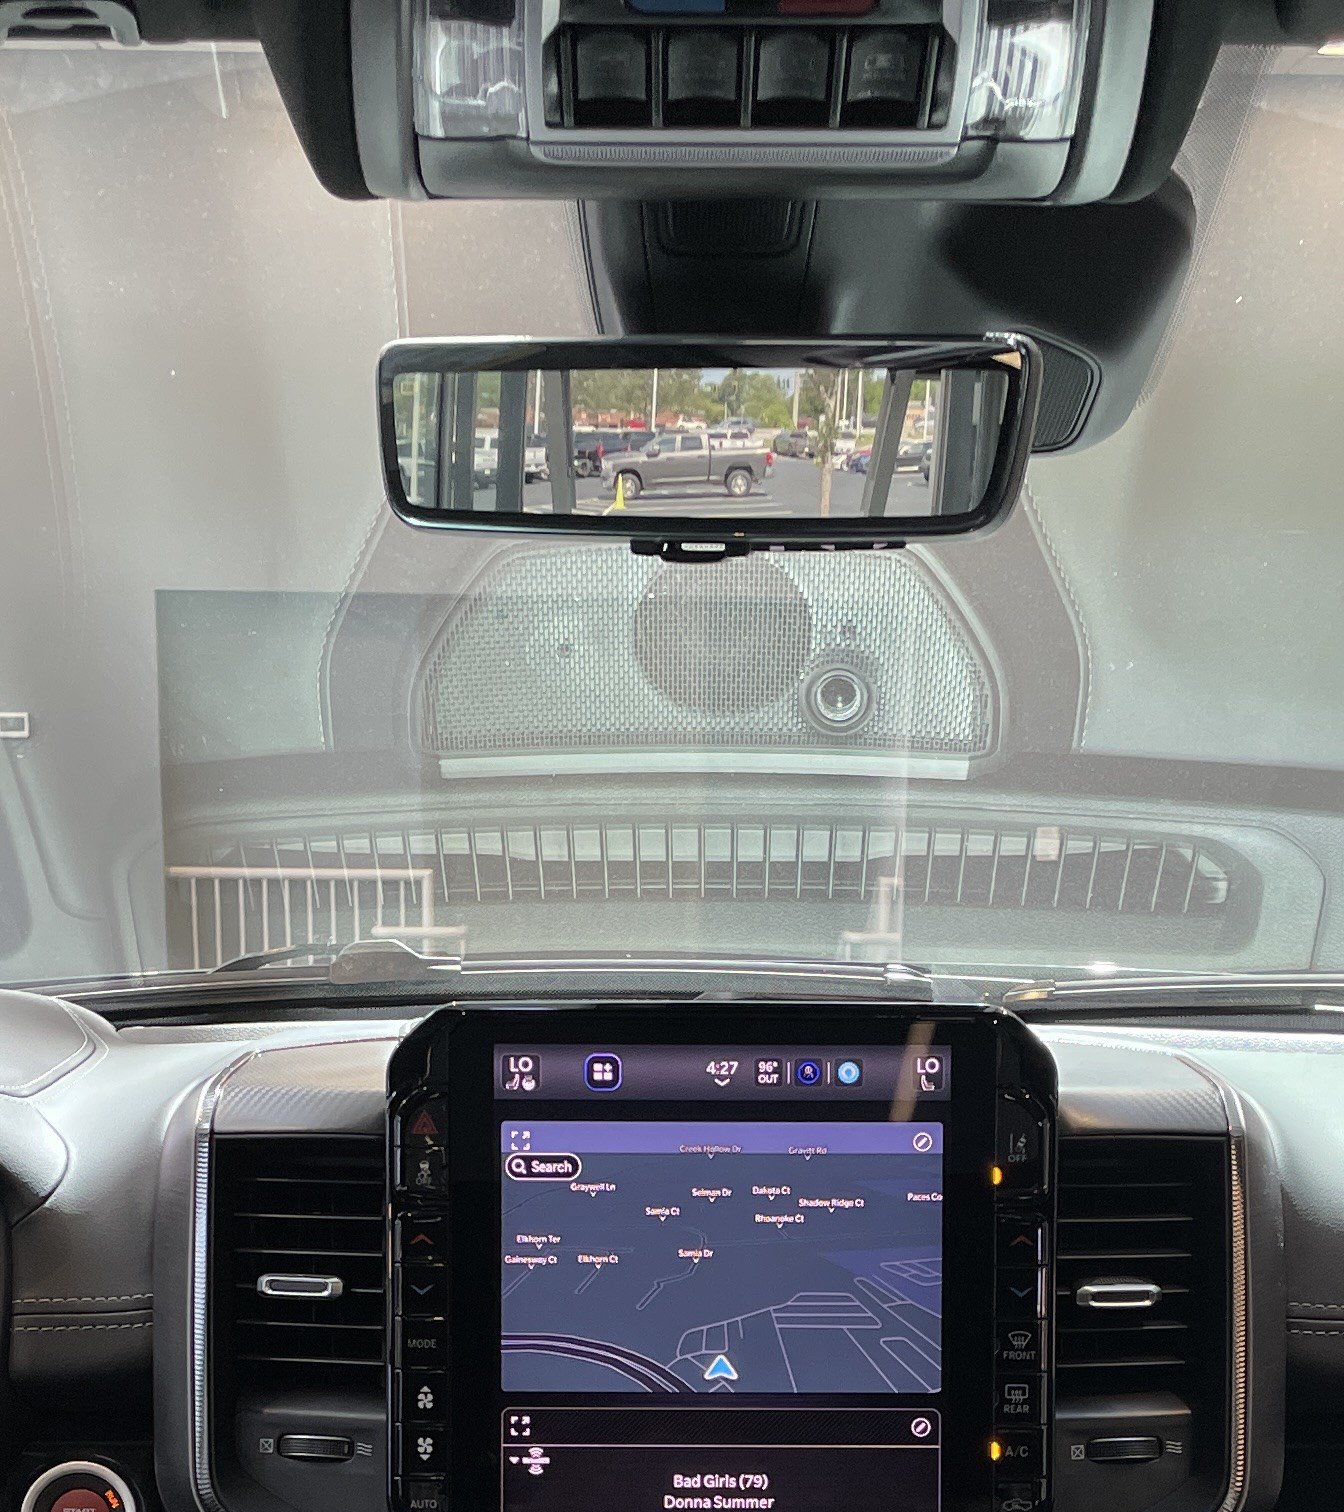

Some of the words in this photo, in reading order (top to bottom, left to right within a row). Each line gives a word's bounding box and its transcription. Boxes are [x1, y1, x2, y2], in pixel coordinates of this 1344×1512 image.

[509, 1057, 533, 1072] LO
[706, 1061, 739, 1078] 4:27
[916, 1058, 940, 1074] LO
[758, 1074, 779, 1085] OUT
[1007, 1152, 1027, 1164] OFF
[531, 1160, 572, 1174] Search
[722, 1188, 733, 1197] Dr
[752, 1186, 780, 1195] Dakota
[781, 1186, 791, 1195] Ct
[907, 1192, 931, 1201] Paces
[799, 1198, 830, 1208] Shadow
[831, 1198, 854, 1209] Ridge
[854, 1198, 865, 1208] Ct
[670, 1206, 681, 1216] Ct
[794, 1214, 805, 1223] Ct
[577, 1254, 609, 1264] Elkhorn
[609, 1254, 619, 1264] Ct
[703, 1249, 714, 1258] Dr
[548, 1255, 558, 1264] Ct
[407, 1338, 437, 1349] MODE
[1002, 1349, 1037, 1361] FRONT
[1003, 1404, 1030, 1415] REAR
[1004, 1445, 1029, 1457] A/C
[673, 1474, 701, 1490] Bad
[703, 1474, 736, 1490] Girls
[739, 1473, 769, 1492] (79)
[410, 1499, 438, 1510] AUTO
[663, 1496, 710, 1510] Donna
[712, 1496, 775, 1510] Summer
